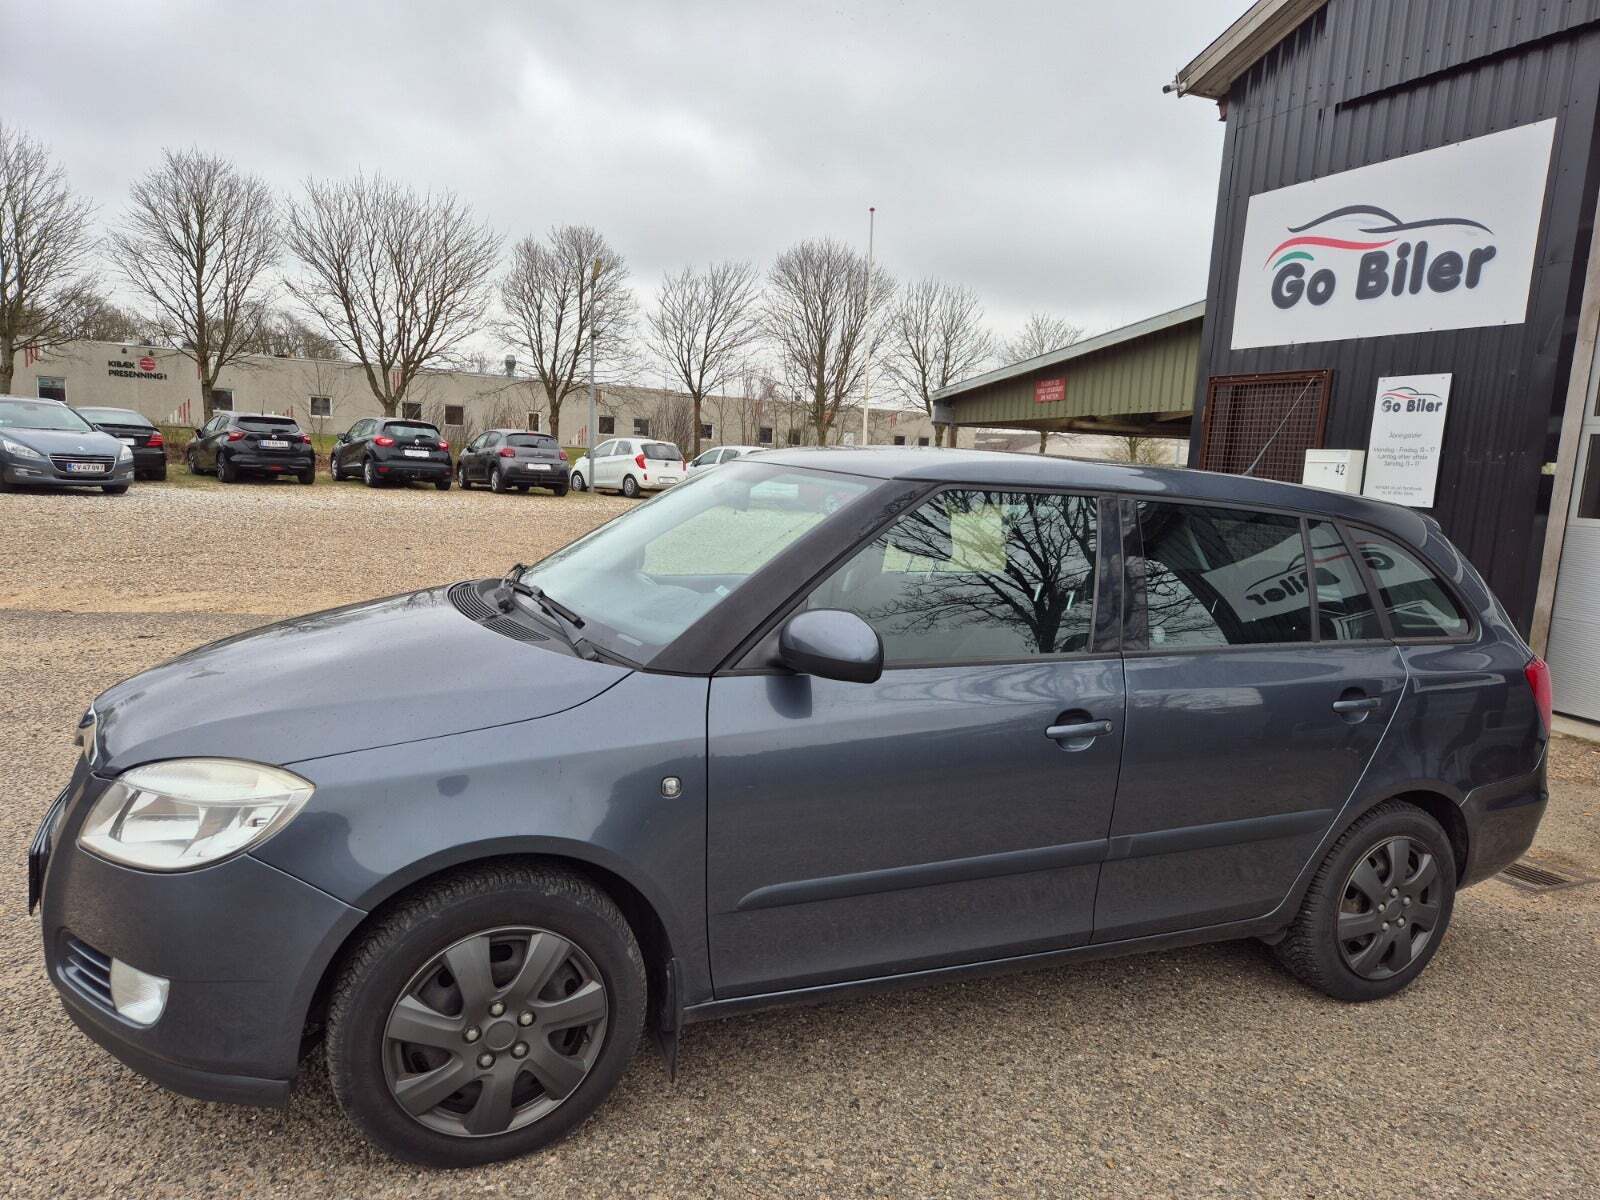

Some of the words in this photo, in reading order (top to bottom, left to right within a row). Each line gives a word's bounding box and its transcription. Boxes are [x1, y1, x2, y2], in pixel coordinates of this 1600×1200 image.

[1271, 262, 1336, 309] Go
[1355, 240, 1496, 300] Biler
[108, 360, 135, 369] KIBÆK
[108, 370, 163, 380] PRESENNING
[1381, 400, 1401, 413] Go
[1406, 398, 1443, 413] Biler
[1335, 464, 1345, 476] 42
